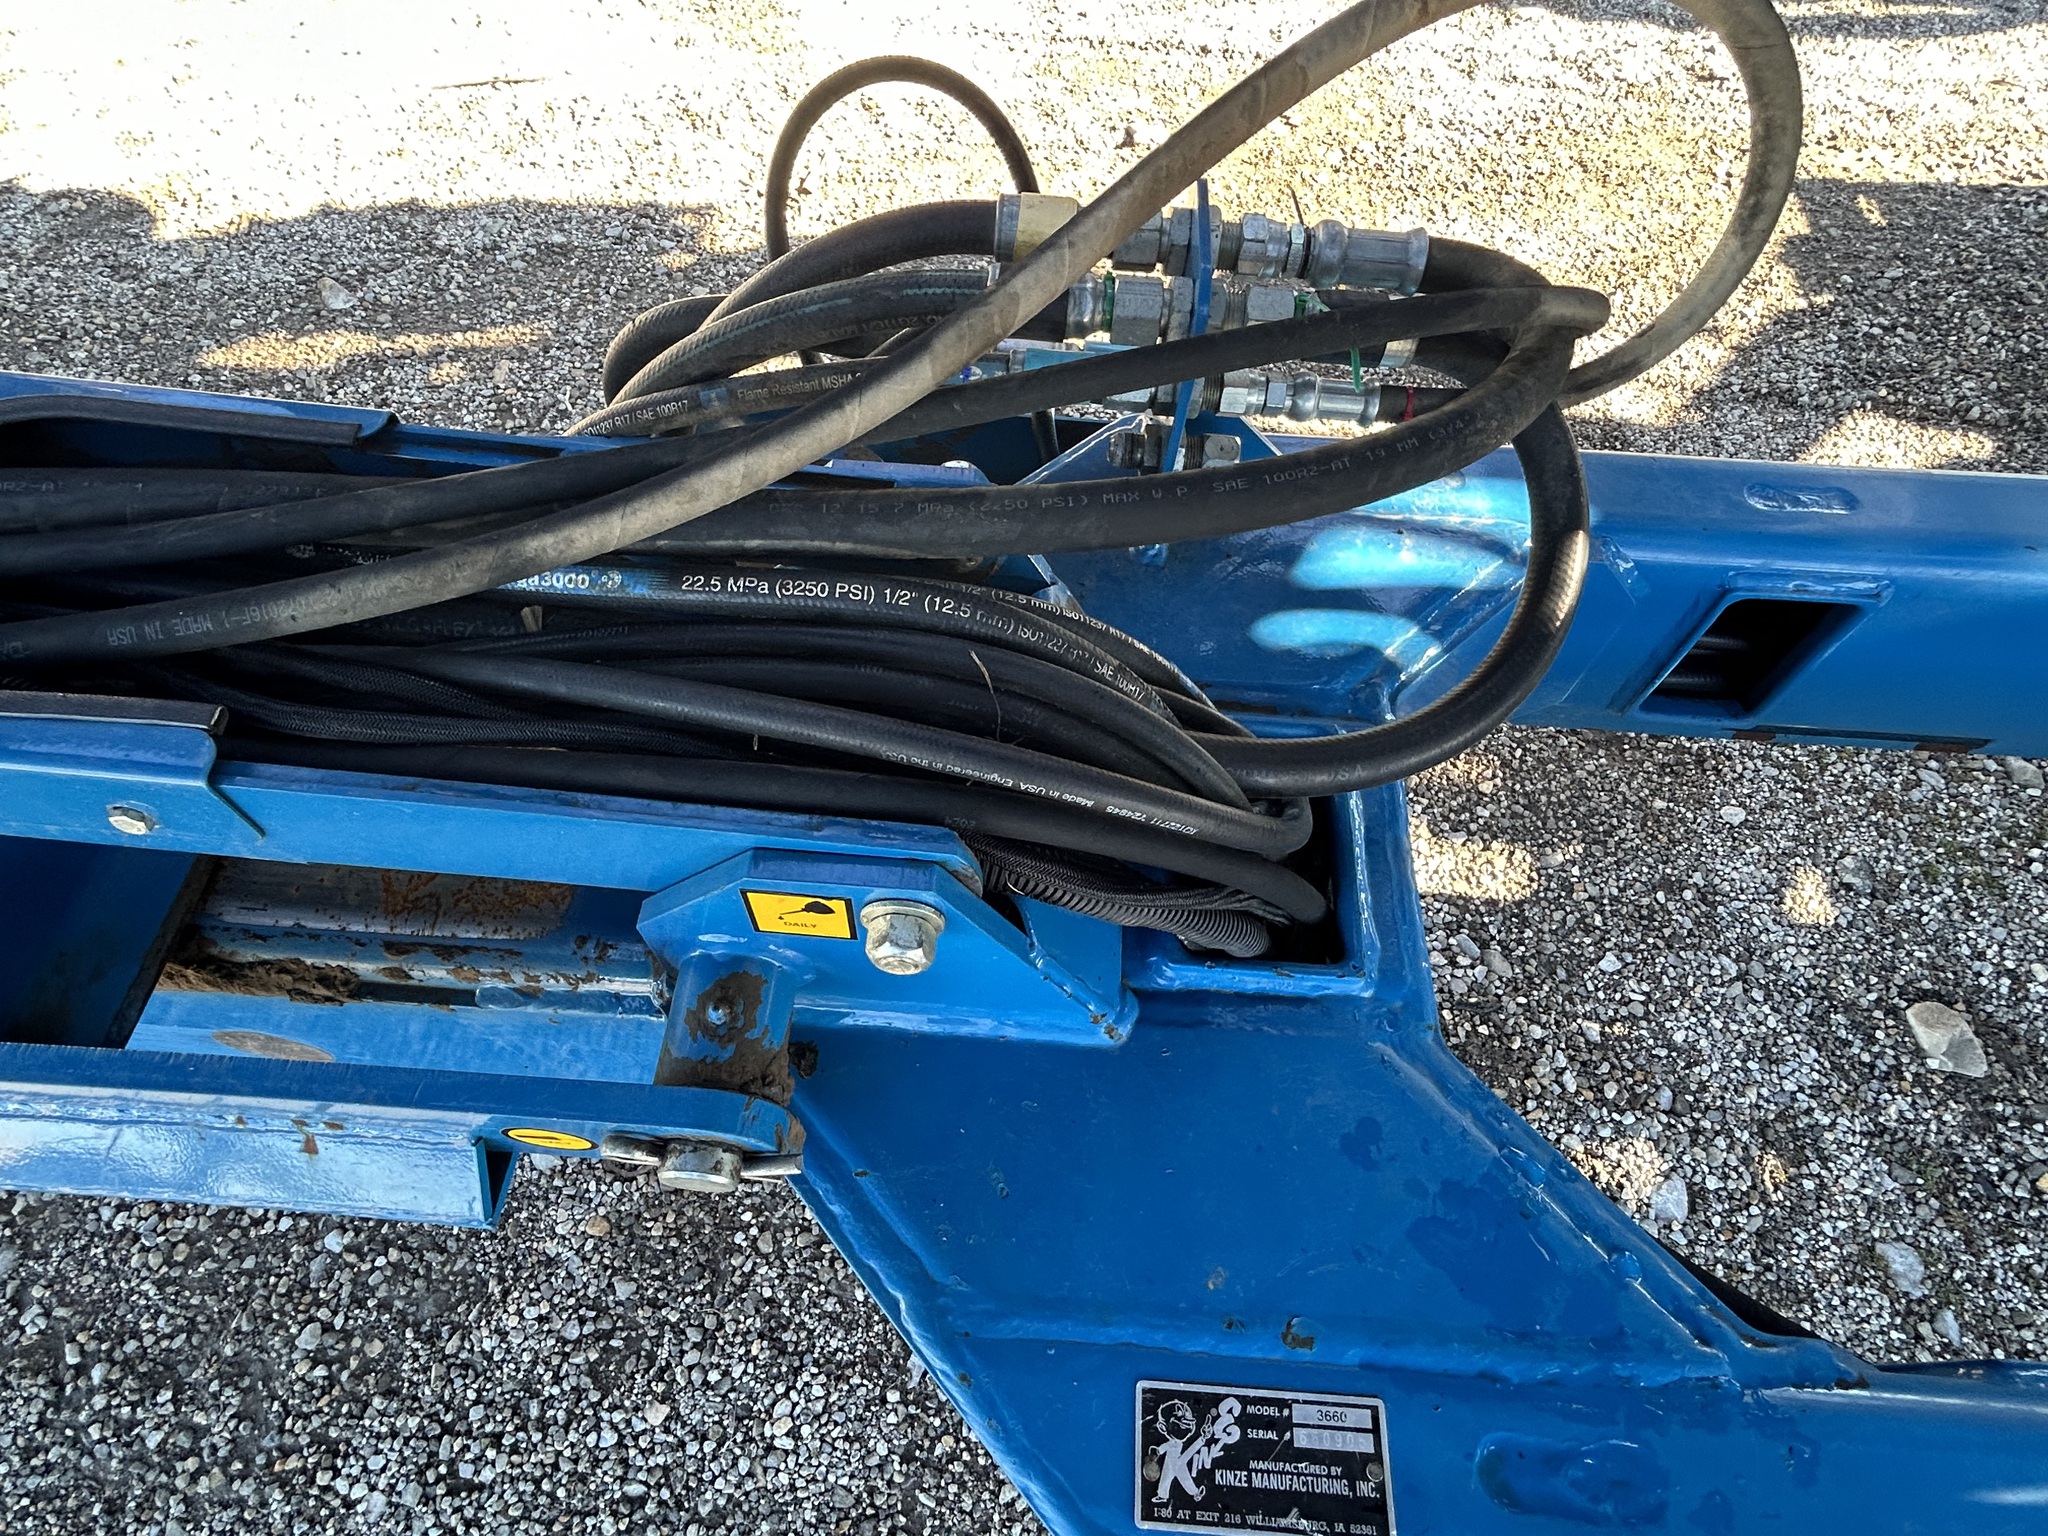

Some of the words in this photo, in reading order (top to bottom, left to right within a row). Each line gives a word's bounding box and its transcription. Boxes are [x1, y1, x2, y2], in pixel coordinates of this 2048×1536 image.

[636, 408, 655, 421] SAE
[656, 400, 689, 417] 100R17
[737, 387, 769, 400] Flame
[772, 378, 820, 396] Resistant
[1212, 478, 1249, 493] SAE
[681, 575, 722, 592] 22.5
[727, 576, 769, 594] MPa
[775, 578, 829, 599] (3250
[835, 583, 875, 605] PSI)
[924, 594, 972, 618] (12.5
[144, 620, 165, 640] IN
[172, 612, 214, 637] MADE
[106, 625, 139, 646] USA
[911, 756, 929, 768] the
[946, 764, 1014, 788] Engineered
[1019, 781, 1046, 796] USA
[1062, 793, 1095, 808] Made
[783, 920, 818, 930] DAILY
[1246, 1405, 1281, 1418] MODEL
[1316, 1410, 1348, 1423] 3660
[1247, 1428, 1279, 1441] SERIAL
[1250, 1460, 1328, 1476] MANUFACTURED
[1330, 1466, 1343, 1477] BY
[1215, 1469, 1249, 1488] KINZE
[1251, 1472, 1353, 1499] MANUFACTURING,
[1356, 1480, 1380, 1499] INC.
[1176, 1509, 1192, 1520] AT
[1195, 1511, 1220, 1522] EXIT
[1224, 1512, 1242, 1524] 216
[1334, 1522, 1347, 1533] IA
